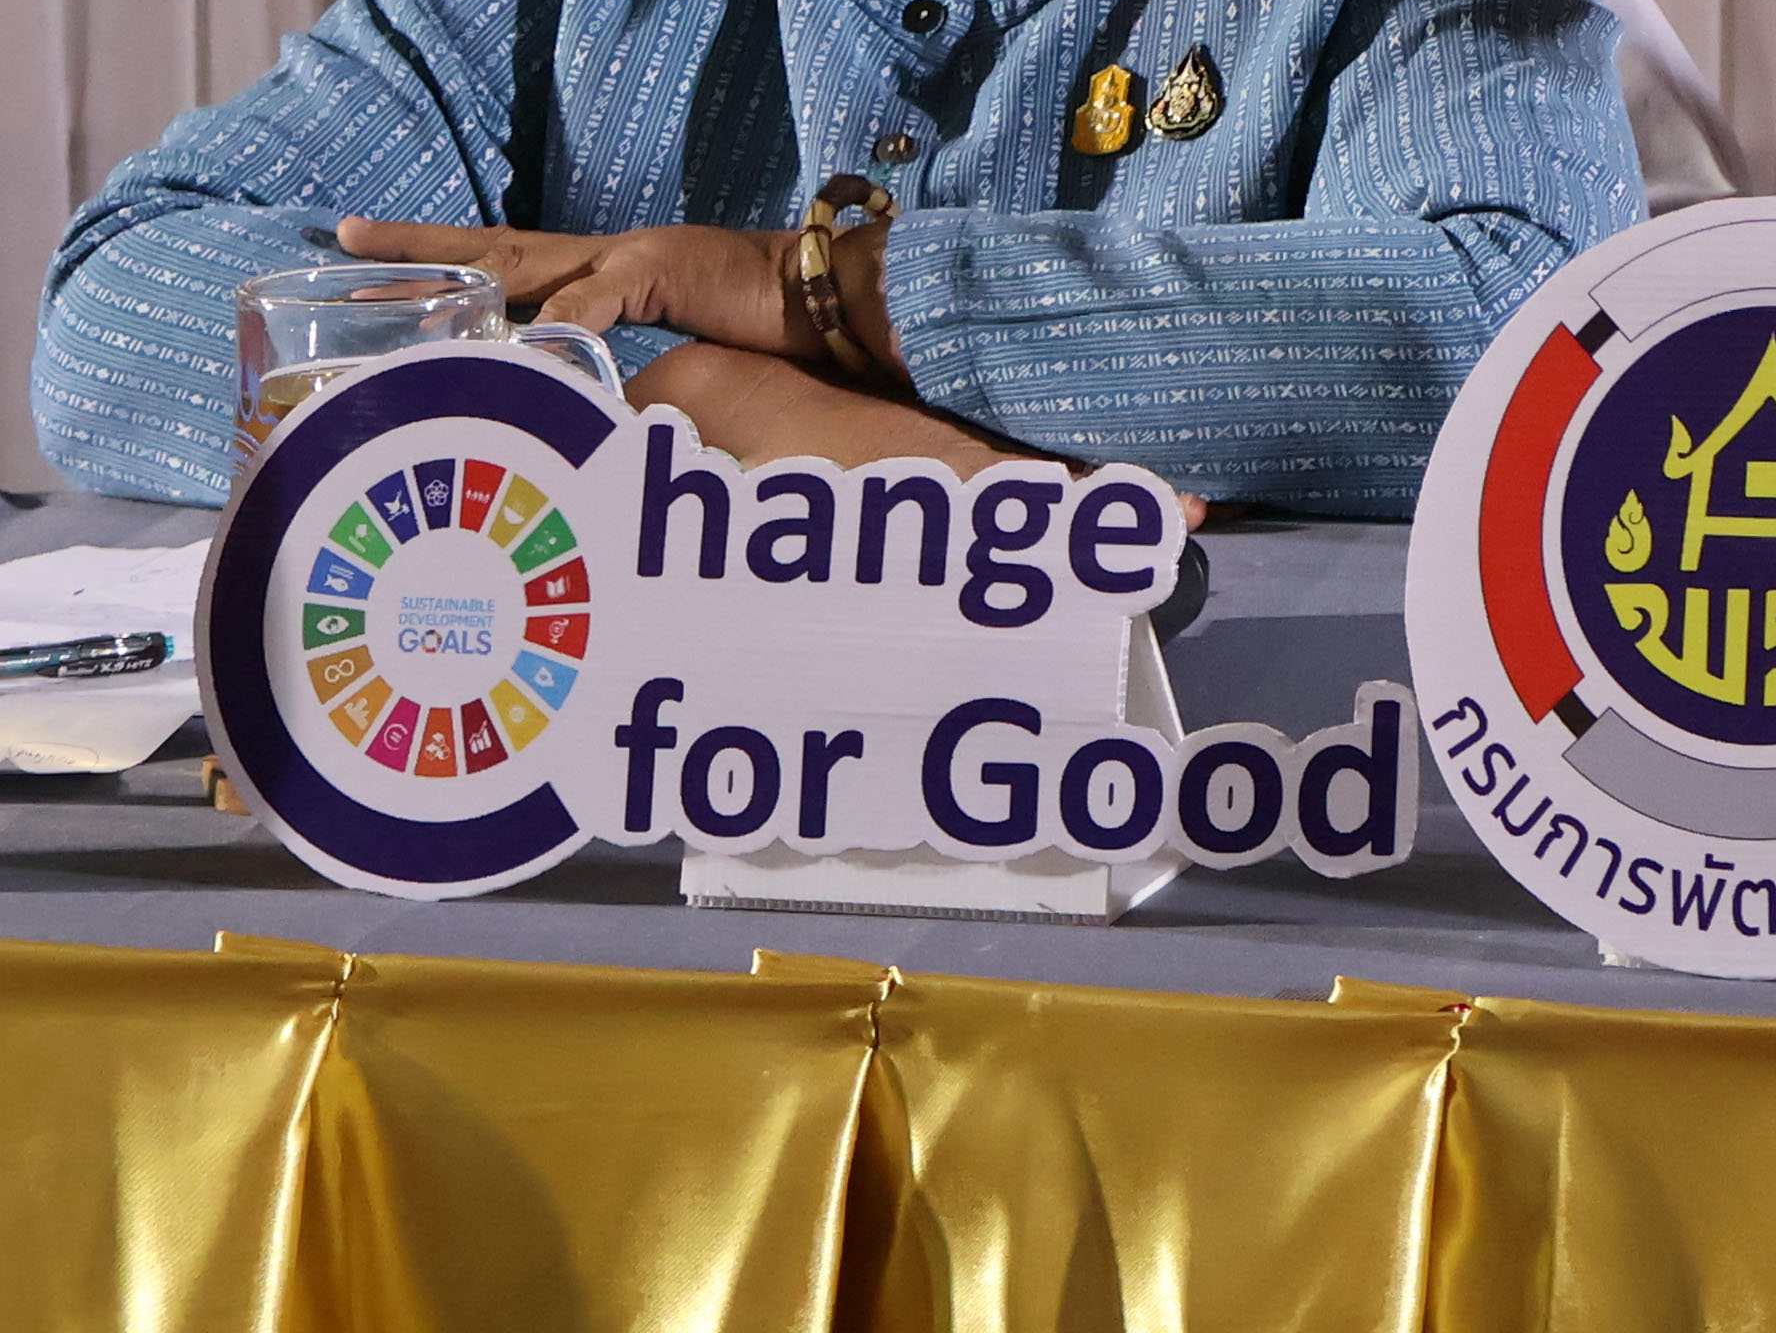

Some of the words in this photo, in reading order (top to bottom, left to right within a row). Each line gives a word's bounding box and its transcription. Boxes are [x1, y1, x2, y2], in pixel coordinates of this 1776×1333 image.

[401, 596, 495, 613] SUSTAINABLE
[398, 612, 495, 629] DEVELOPMENT
[398, 628, 492, 656] GOALS
[614, 677, 864, 839] for
[921, 697, 1401, 858] Good
